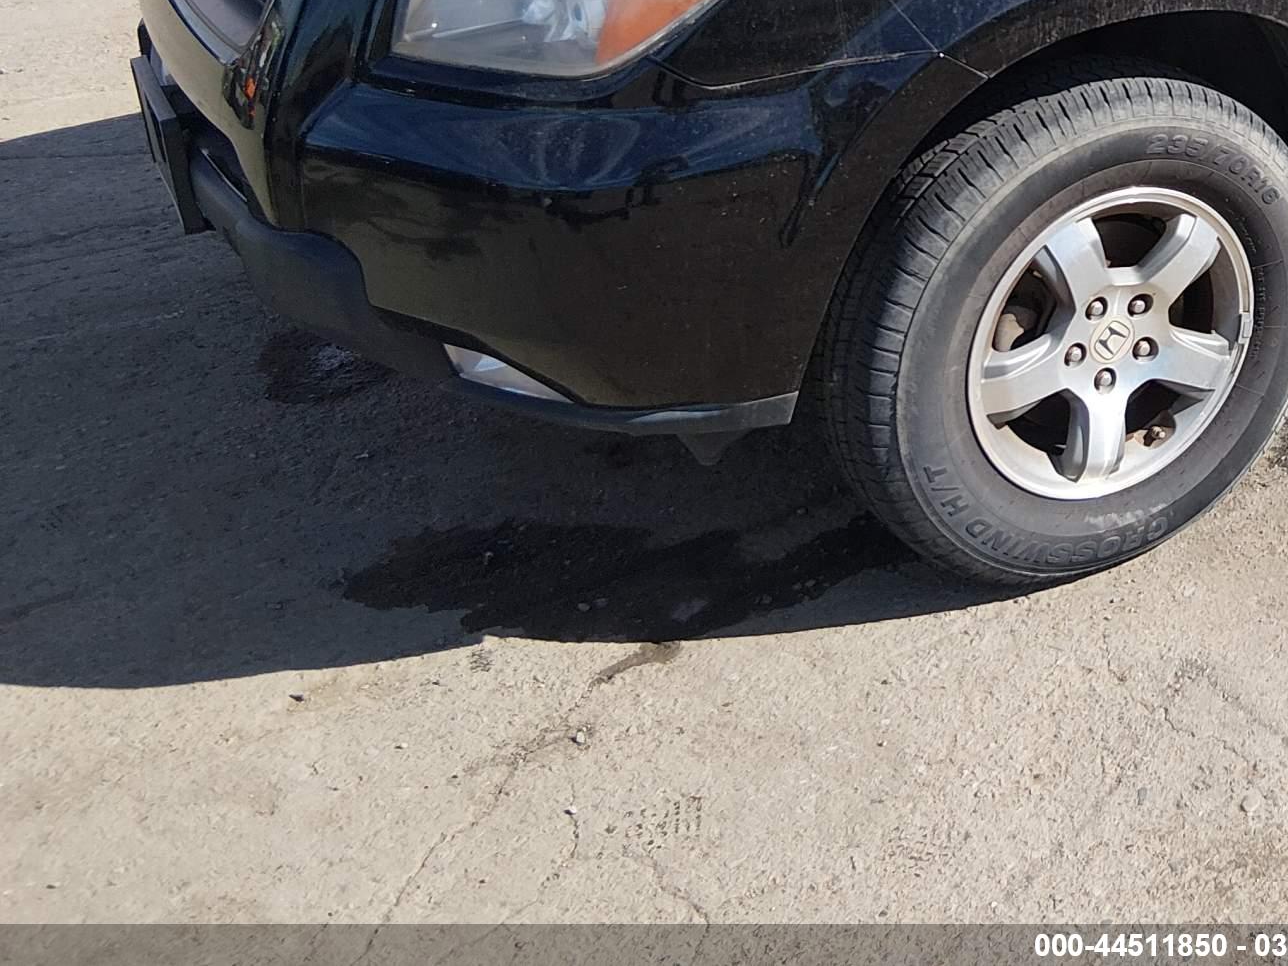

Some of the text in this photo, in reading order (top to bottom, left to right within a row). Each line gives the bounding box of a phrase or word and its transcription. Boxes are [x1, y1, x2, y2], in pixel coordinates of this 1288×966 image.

[1146, 133, 1281, 205] 235/70R16
[923, 464, 1169, 564] CROSSWIND H/T
